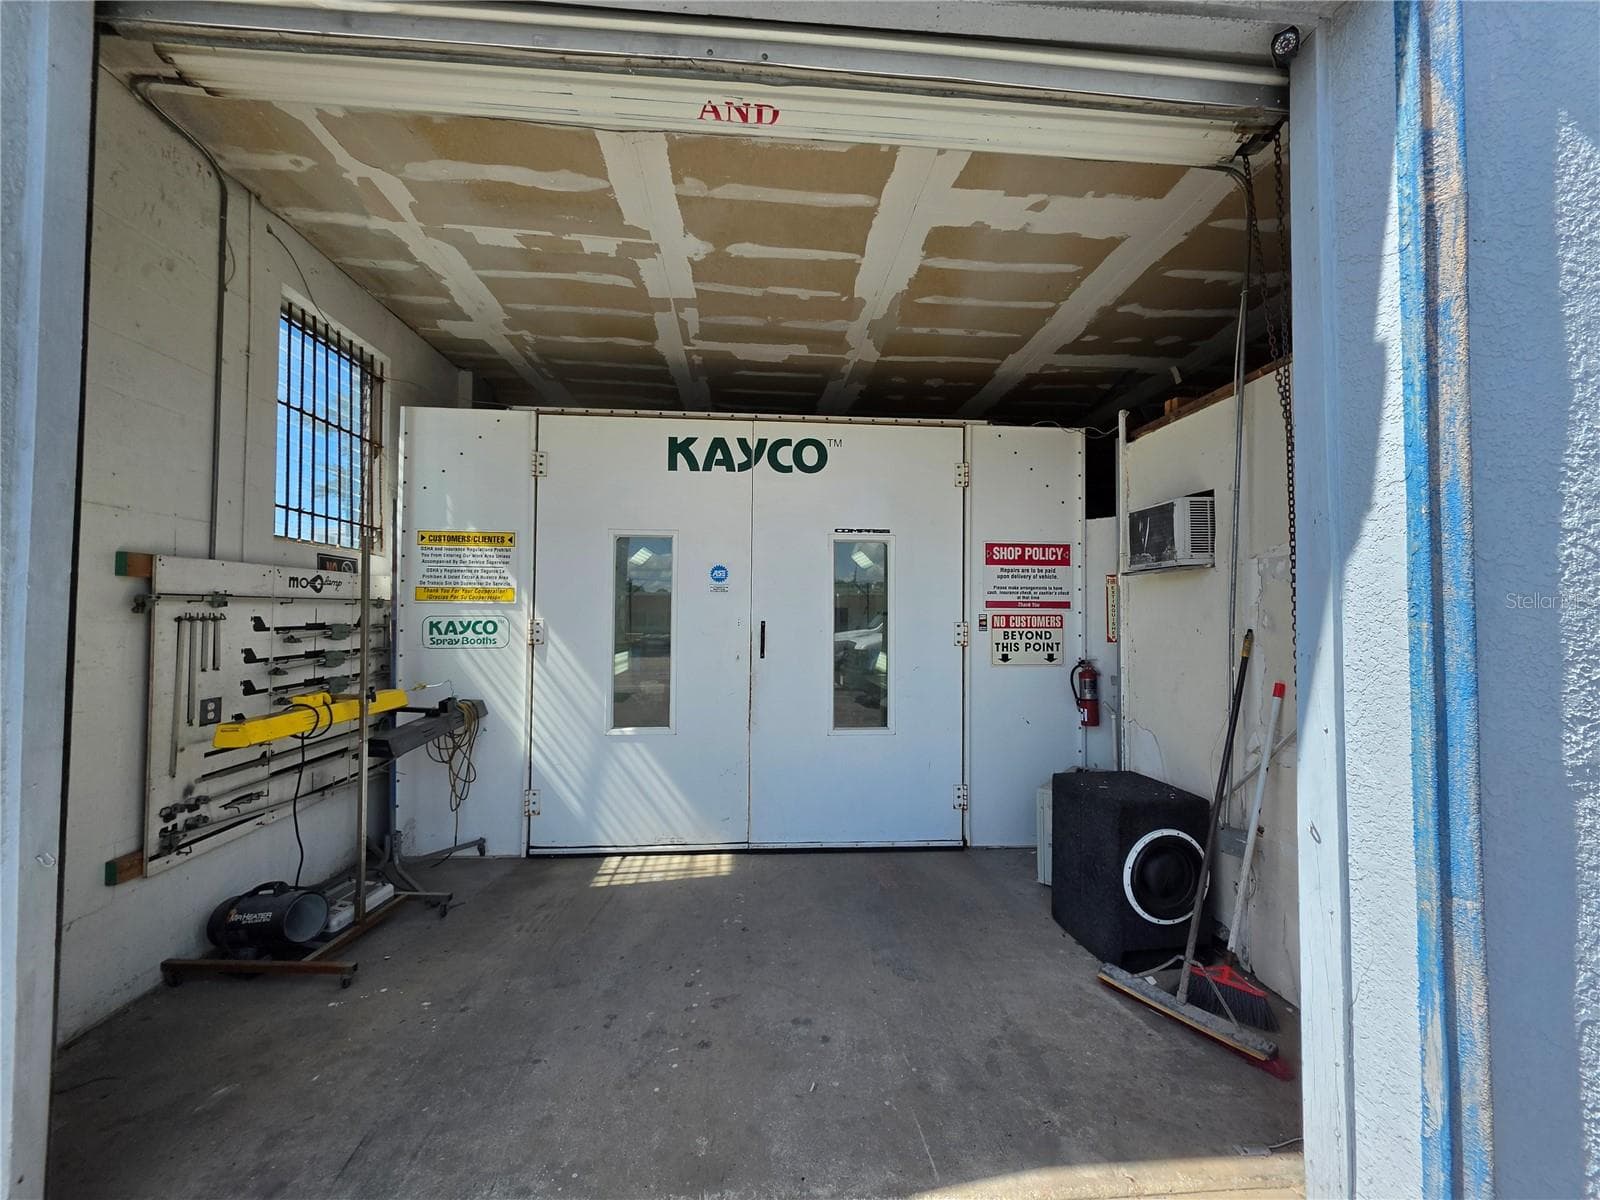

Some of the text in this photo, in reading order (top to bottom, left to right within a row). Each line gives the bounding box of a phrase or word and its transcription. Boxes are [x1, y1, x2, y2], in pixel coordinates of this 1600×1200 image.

[697, 100, 780, 125] AND
[667, 437, 828, 474] KAYCO
[992, 546, 1063, 560] SHOP POLICY
[428, 620, 498, 635] KAYCO
[993, 616, 1006, 627] NO
[1009, 616, 1062, 627] CUSTOMERS
[429, 637, 497, 646] Spray Booths
[1003, 631, 1052, 640] BEYOND
[995, 642, 1061, 652] THIS POINT
